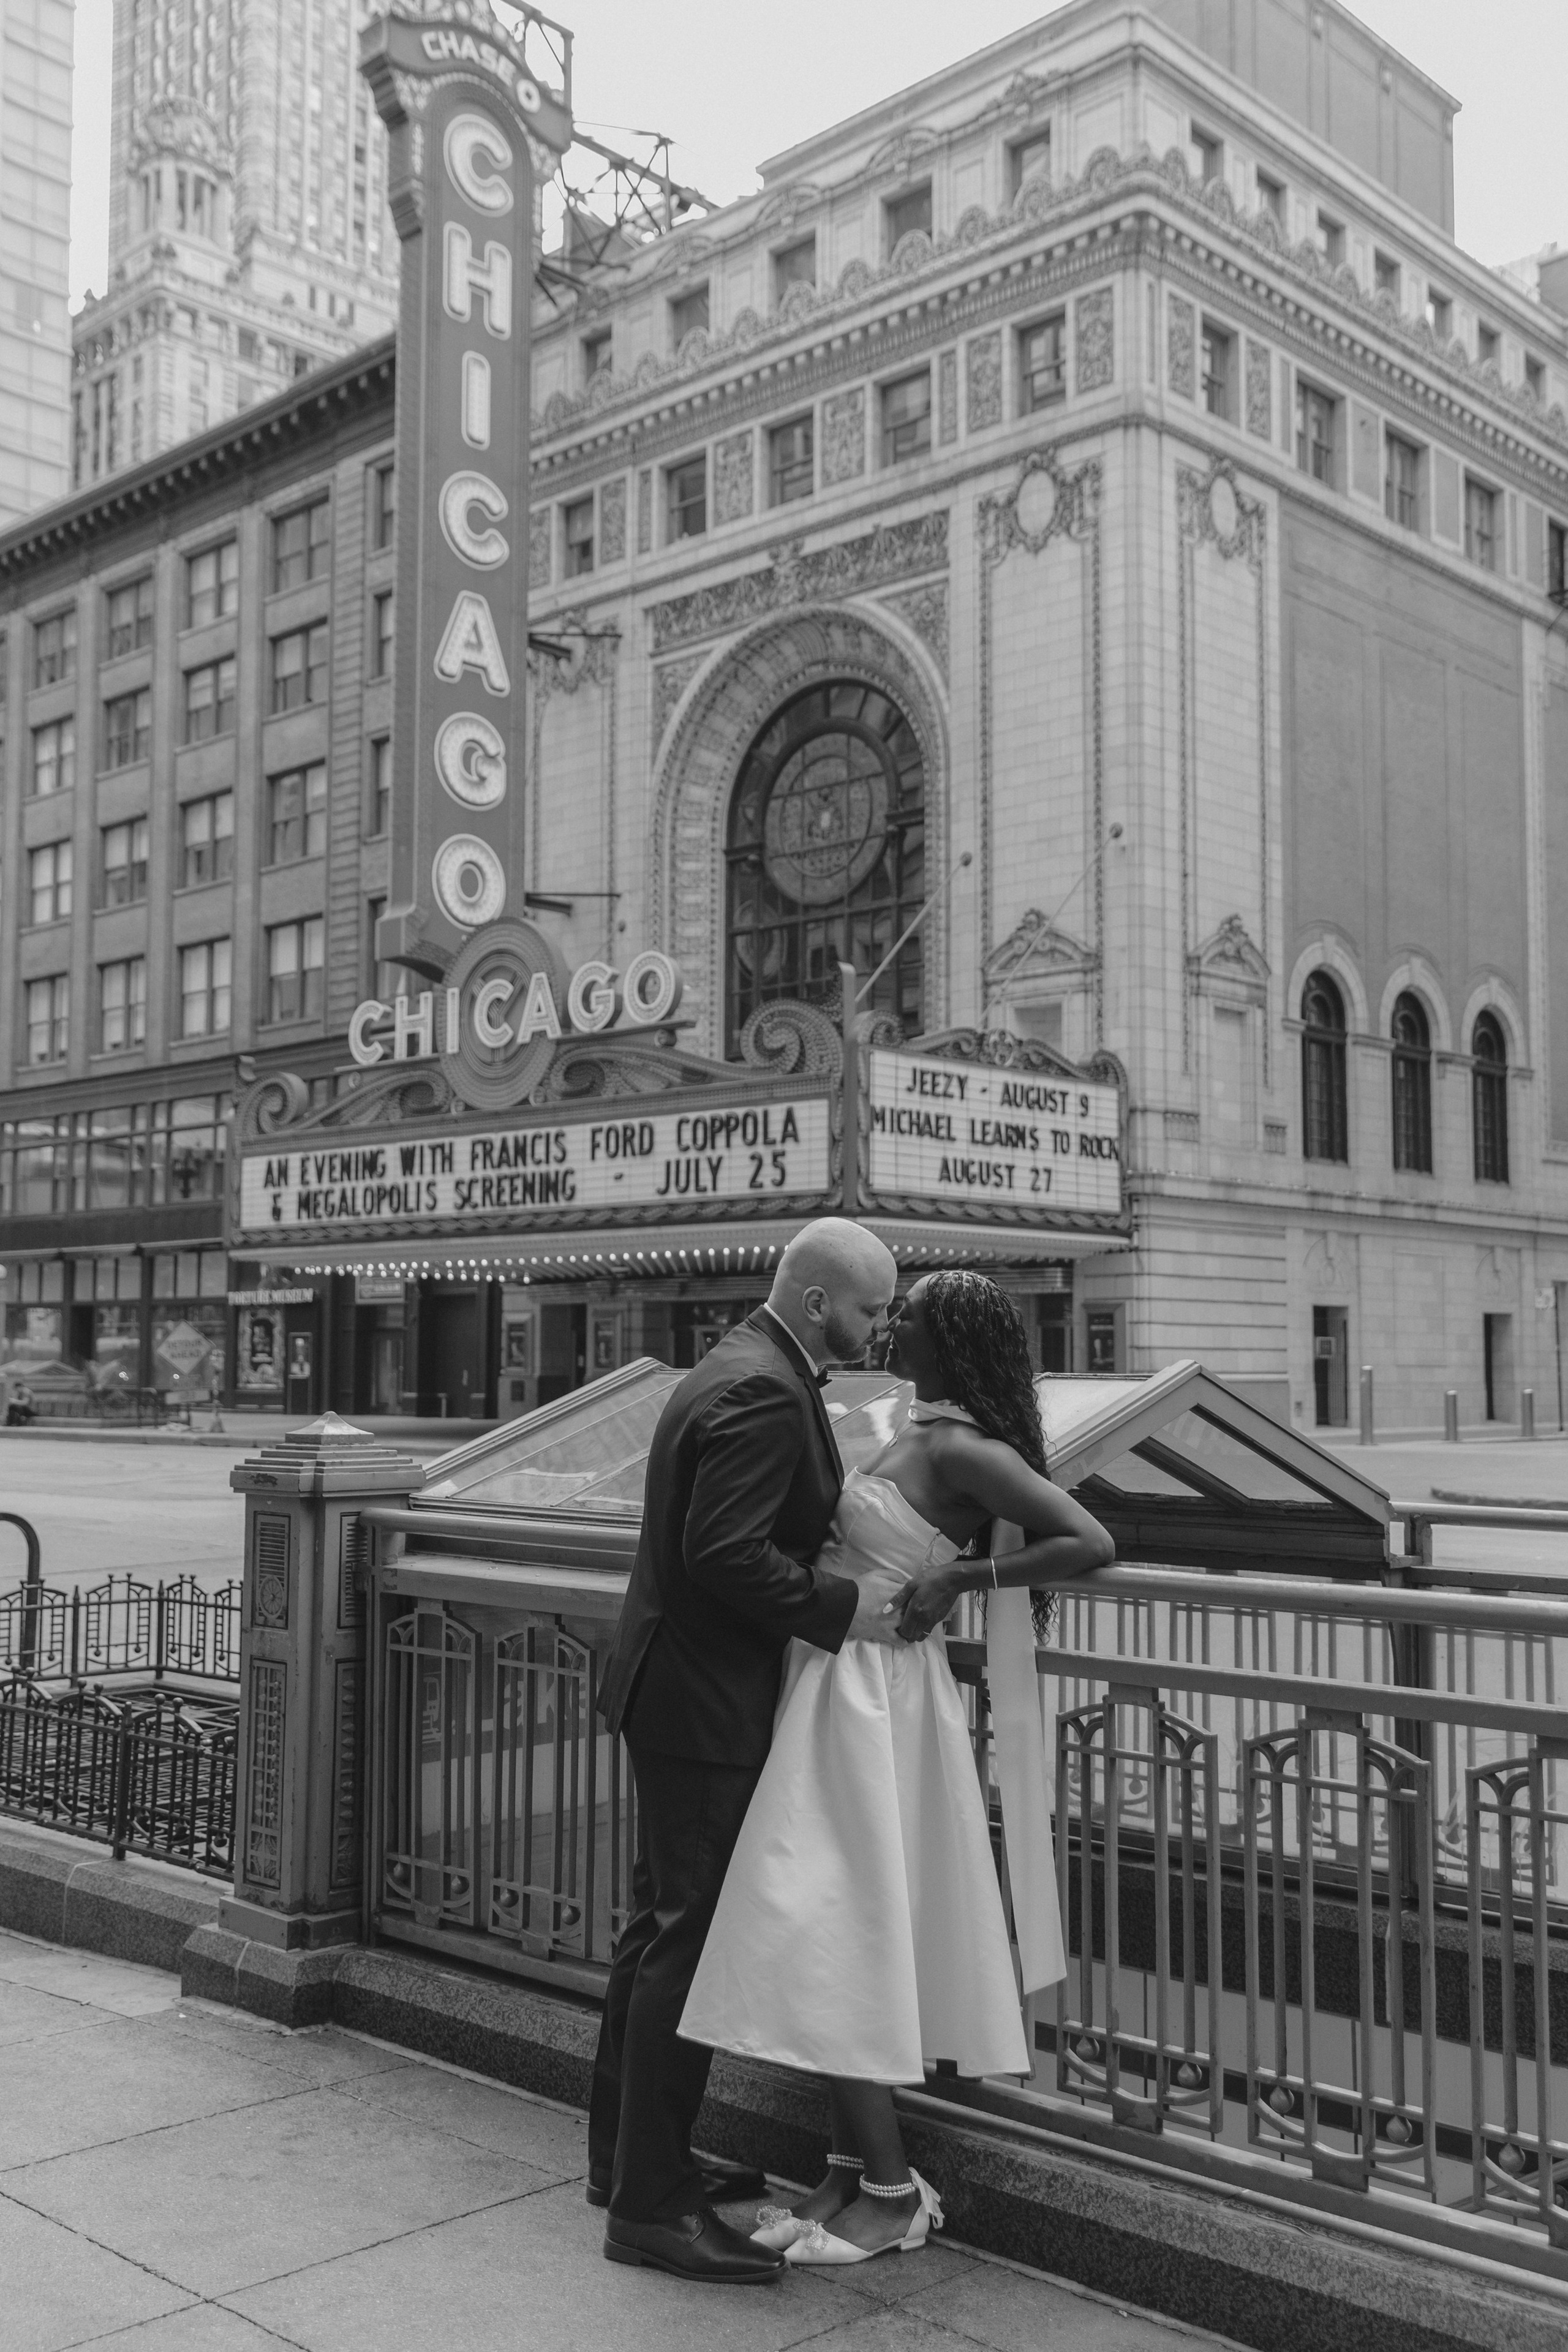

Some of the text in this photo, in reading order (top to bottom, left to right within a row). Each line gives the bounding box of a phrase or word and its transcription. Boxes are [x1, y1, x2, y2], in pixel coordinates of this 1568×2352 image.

[421, 31, 517, 88] CHASE
[431, 113, 513, 932] CHICAGO
[348, 950, 681, 1066] CHICAGO
[906, 1067, 968, 1101] JEEZY
[1001, 1081, 1069, 1115] AUGUST
[1080, 1094, 1089, 1117] 9
[264, 1106, 800, 1189] AN EVENING WITH FRANCIS FORD COPPOLA
[870, 1104, 1119, 1161] MICHAEL LEARNS TO ROCK
[298, 1177, 437, 1220] MEGALOPOLIS
[454, 1167, 576, 1210] SCREENING
[657, 1156, 723, 1196] JULY
[749, 1149, 786, 1189] 25
[939, 1155, 1052, 1193] AUGUST 27
